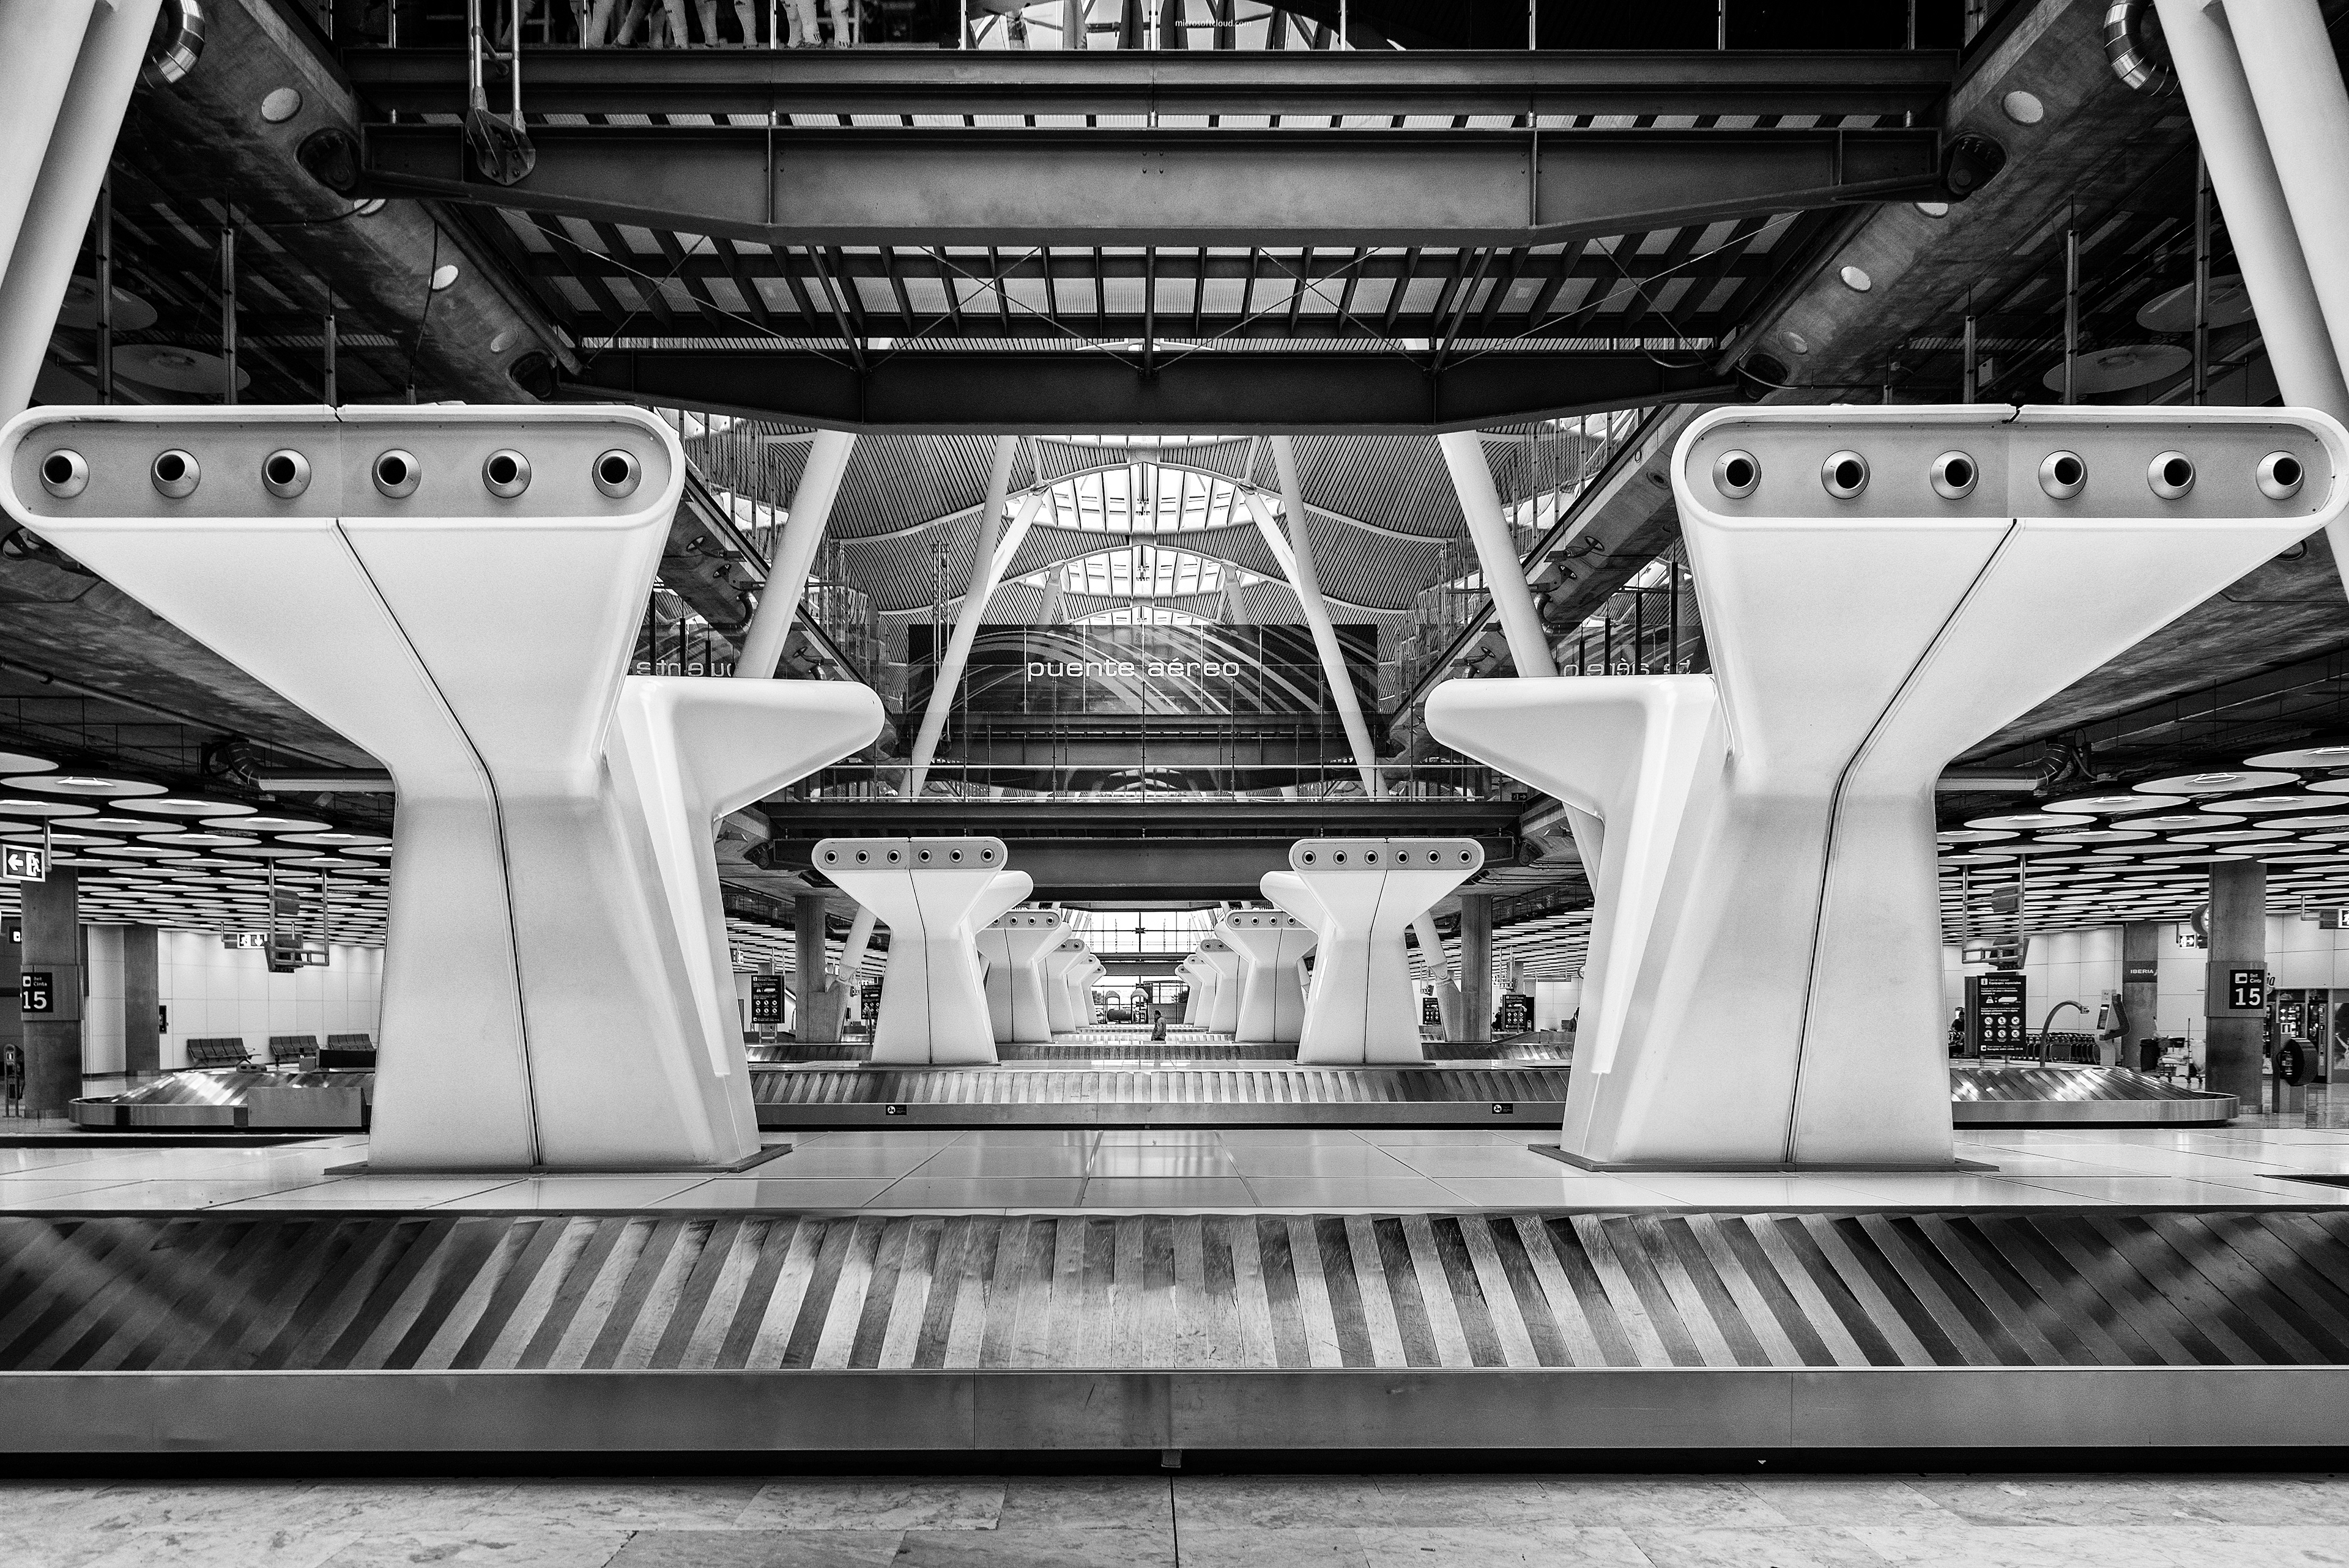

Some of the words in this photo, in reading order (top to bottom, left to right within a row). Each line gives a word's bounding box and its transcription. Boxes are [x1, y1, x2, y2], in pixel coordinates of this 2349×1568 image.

[1175, 19, 1252, 28] microsoftcloud.com
[1028, 659, 1135, 682] puente
[1148, 657, 1240, 676] aéreo
[23, 991, 47, 1009] 15
[2235, 988, 2261, 1006] 15
